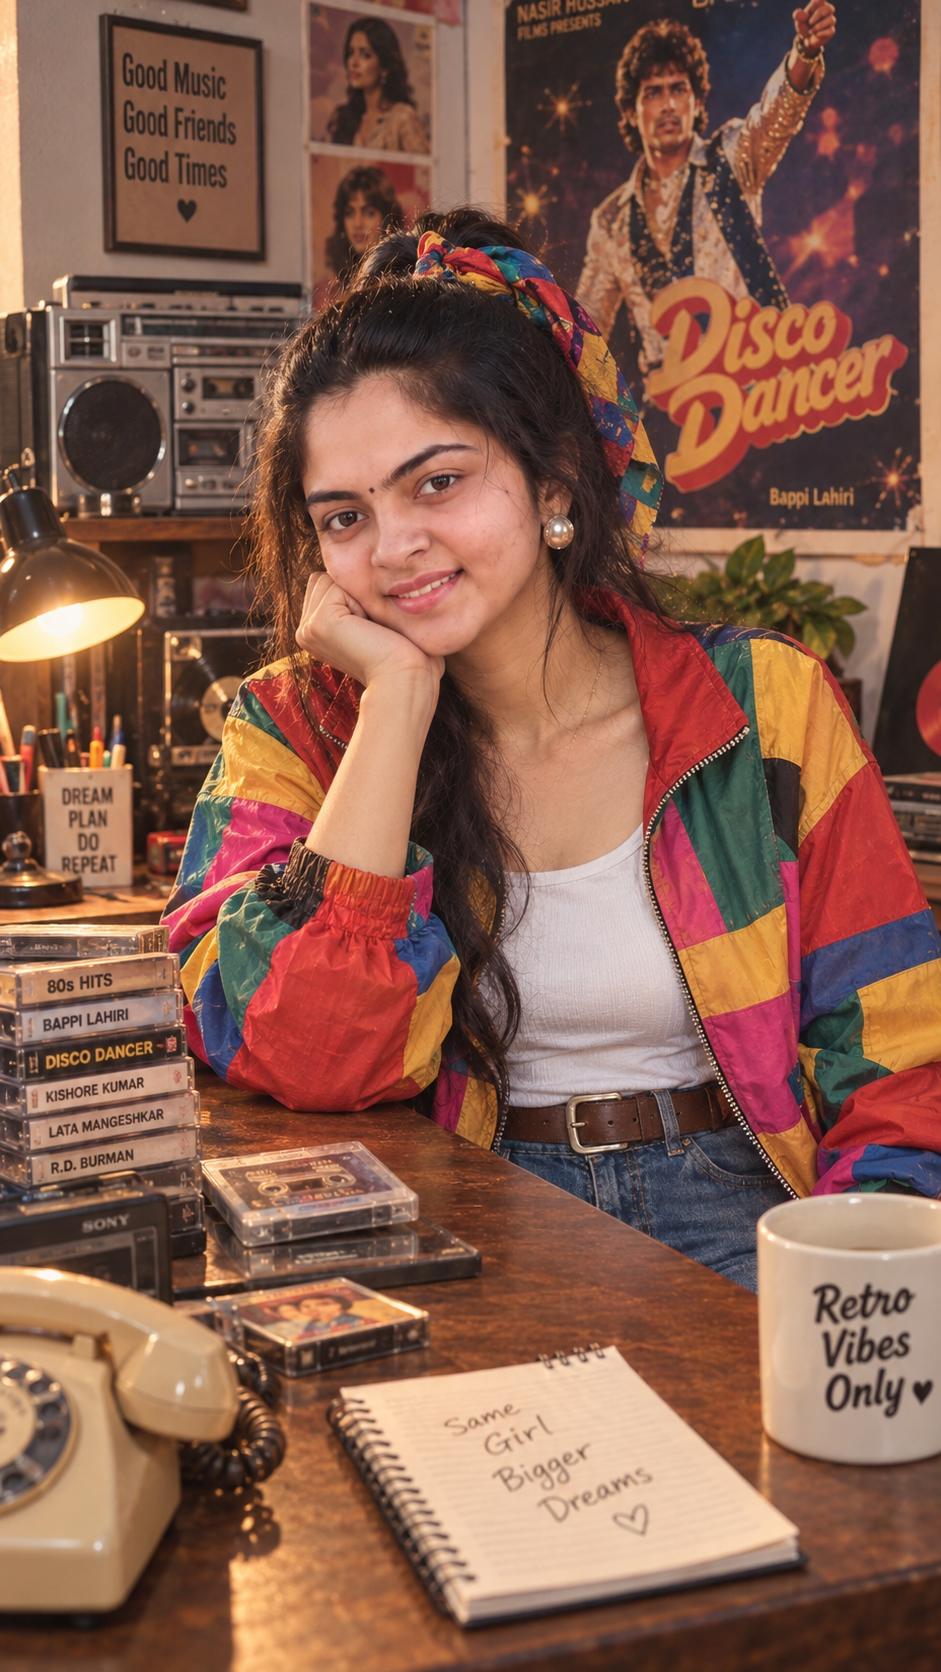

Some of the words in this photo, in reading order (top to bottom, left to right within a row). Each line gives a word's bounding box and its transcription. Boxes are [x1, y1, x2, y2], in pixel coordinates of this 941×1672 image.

[517, 0, 561, 23] NASIR
[517, 22, 548, 41] FILMS
[550, 12, 602, 34] PRESENTS
[122, 52, 168, 92] Good
[174, 61, 226, 100] Music
[123, 99, 168, 137] Good
[174, 106, 237, 145] Friends
[124, 146, 169, 183] Good
[174, 152, 228, 188] Times
[648, 276, 846, 402] Disco
[665, 335, 901, 484] Dancer
[769, 487, 809, 510] Bappi
[62, 787, 114, 806] DREAM
[69, 810, 108, 829] PLAN
[78, 833, 100, 852] DO
[62, 855, 117, 874] REPEAT
[47, 978, 74, 994] 80s
[79, 973, 113, 990] HITS
[43, 1014, 82, 1032] BAPPI
[87, 1008, 129, 1026] LAHIRI
[45, 1050, 91, 1070] DISCO
[95, 1041, 153, 1063] DANCER
[46, 1084, 98, 1103] KISHORE
[102, 1077, 145, 1094] KUMAR
[49, 1124, 79, 1138] LATA
[82, 1108, 164, 1133] MANGESHKAR
[51, 1159, 77, 1175] R.D.
[80, 1149, 134, 1169] BURMAN
[82, 1213, 129, 1233] SONY
[813, 1283, 916, 1325] Retro
[823, 1325, 911, 1369] Vibes
[825, 1367, 905, 1419] Only
[444, 1403, 522, 1437] Same
[484, 1414, 554, 1456] Girl
[491, 1443, 591, 1493] Bigger
[536, 1467, 654, 1524] Dreams
